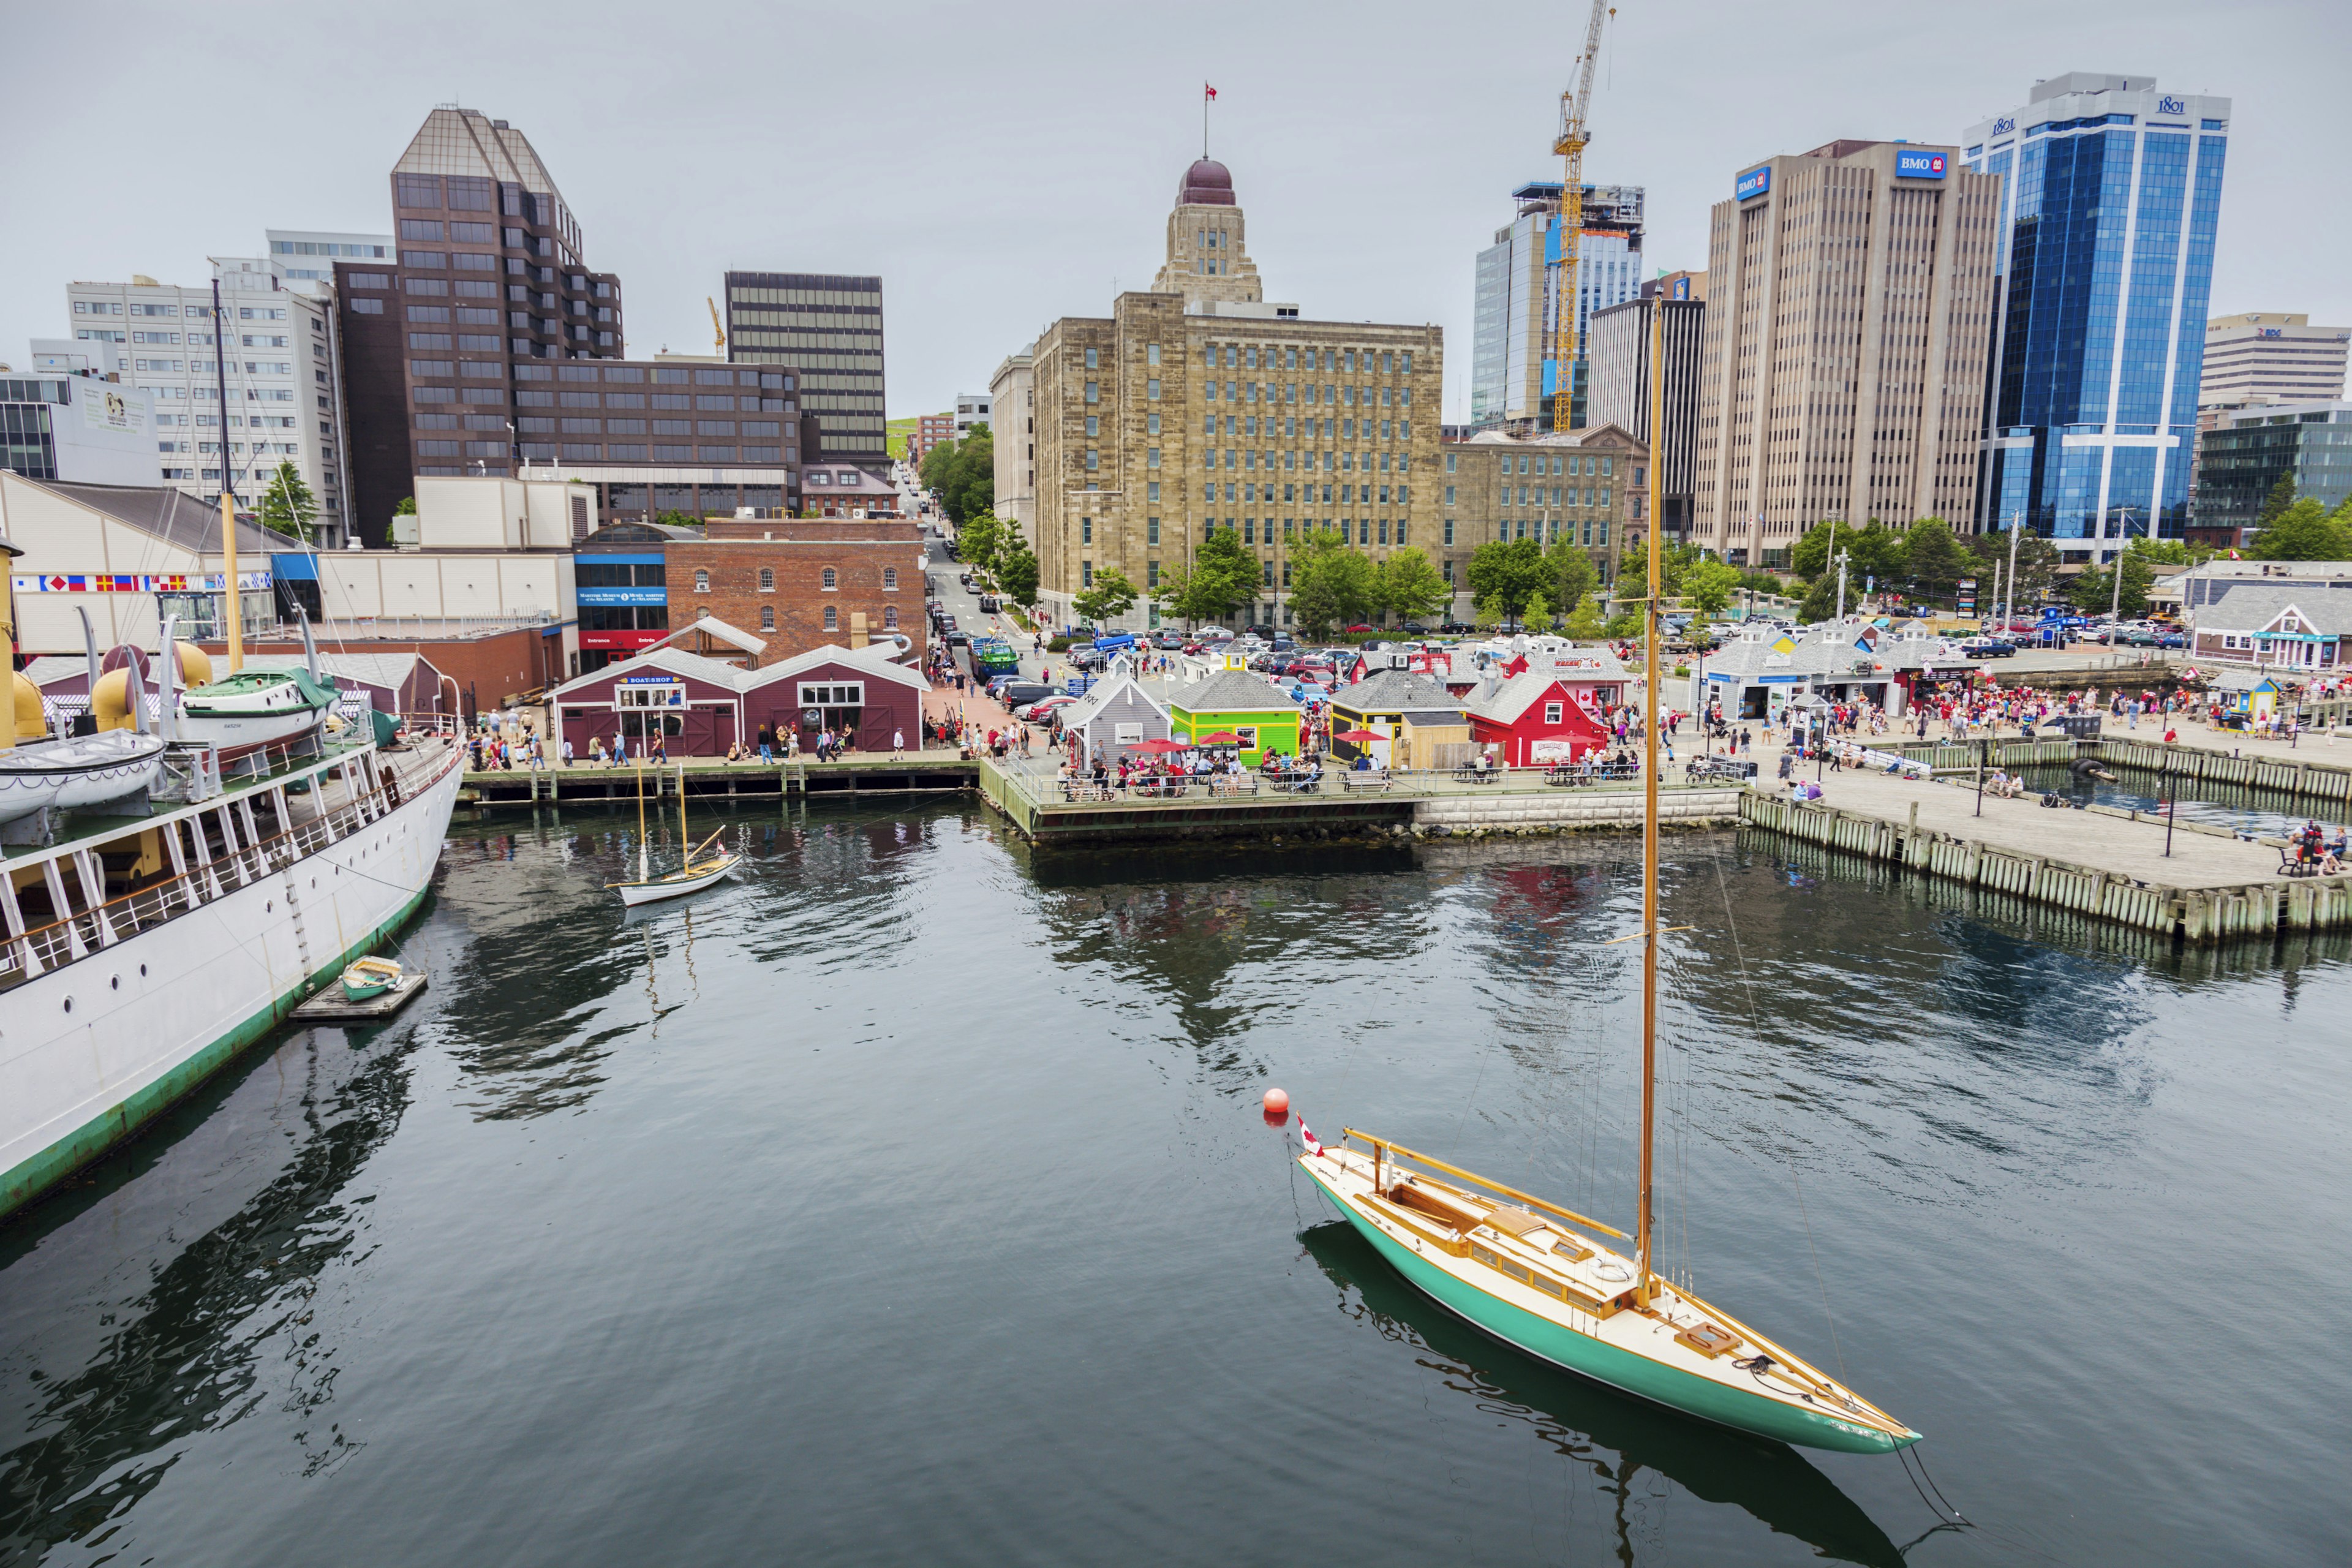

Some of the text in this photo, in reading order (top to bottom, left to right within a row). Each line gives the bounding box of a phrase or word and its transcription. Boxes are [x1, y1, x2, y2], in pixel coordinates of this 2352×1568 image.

[2158, 96, 2184, 113] 1801
[1993, 118, 2015, 135] 1801
[1901, 157, 1929, 170] BMO
[1738, 178, 1756, 194] BMO
